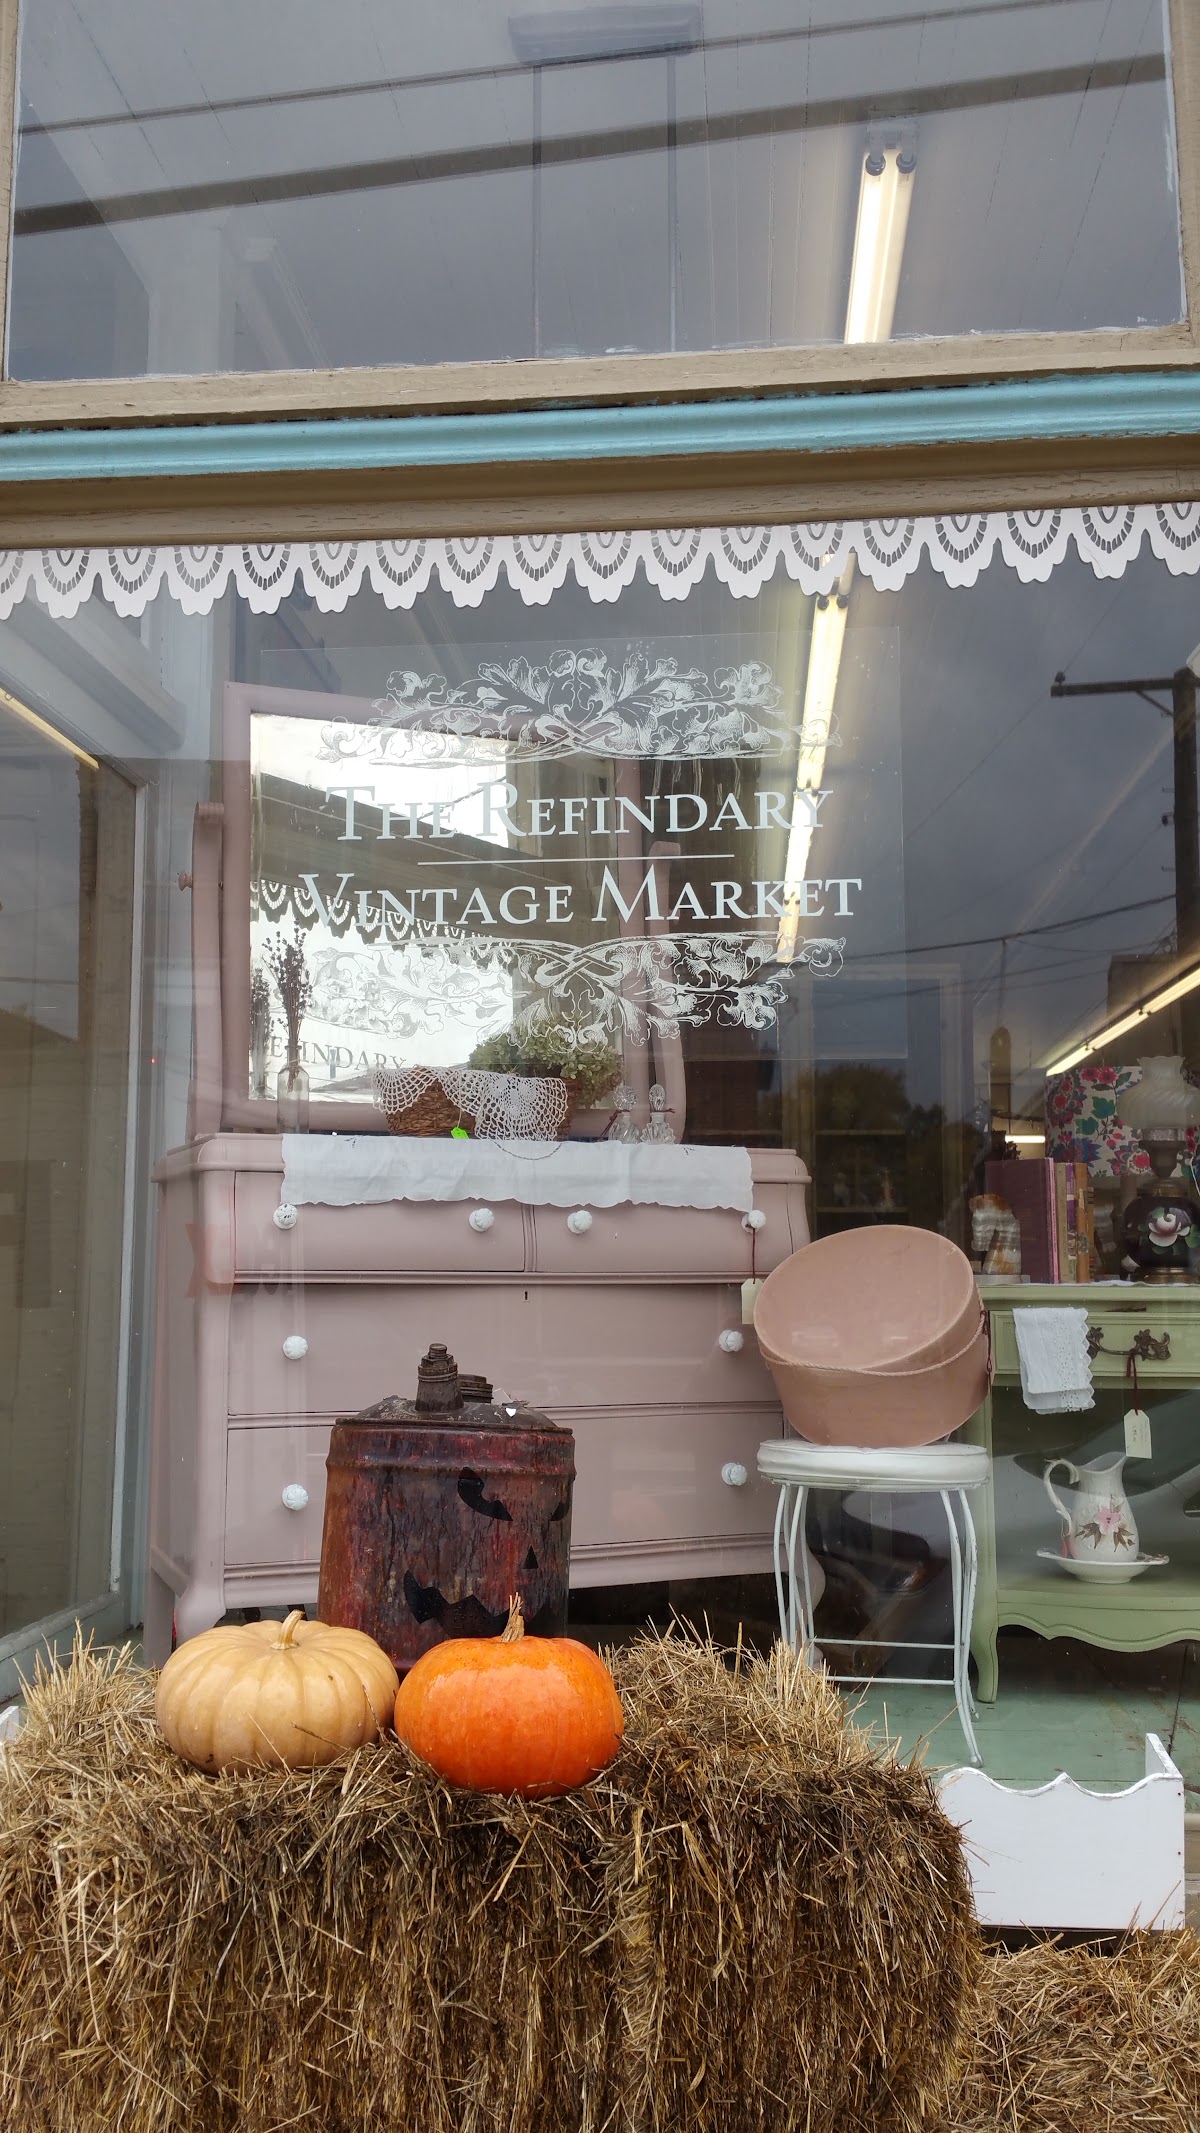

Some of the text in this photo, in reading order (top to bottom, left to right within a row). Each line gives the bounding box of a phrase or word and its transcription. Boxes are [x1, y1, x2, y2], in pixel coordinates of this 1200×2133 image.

[326, 781, 834, 841] THE REFINDARY
[298, 864, 862, 928] VINTAGE MARKET
